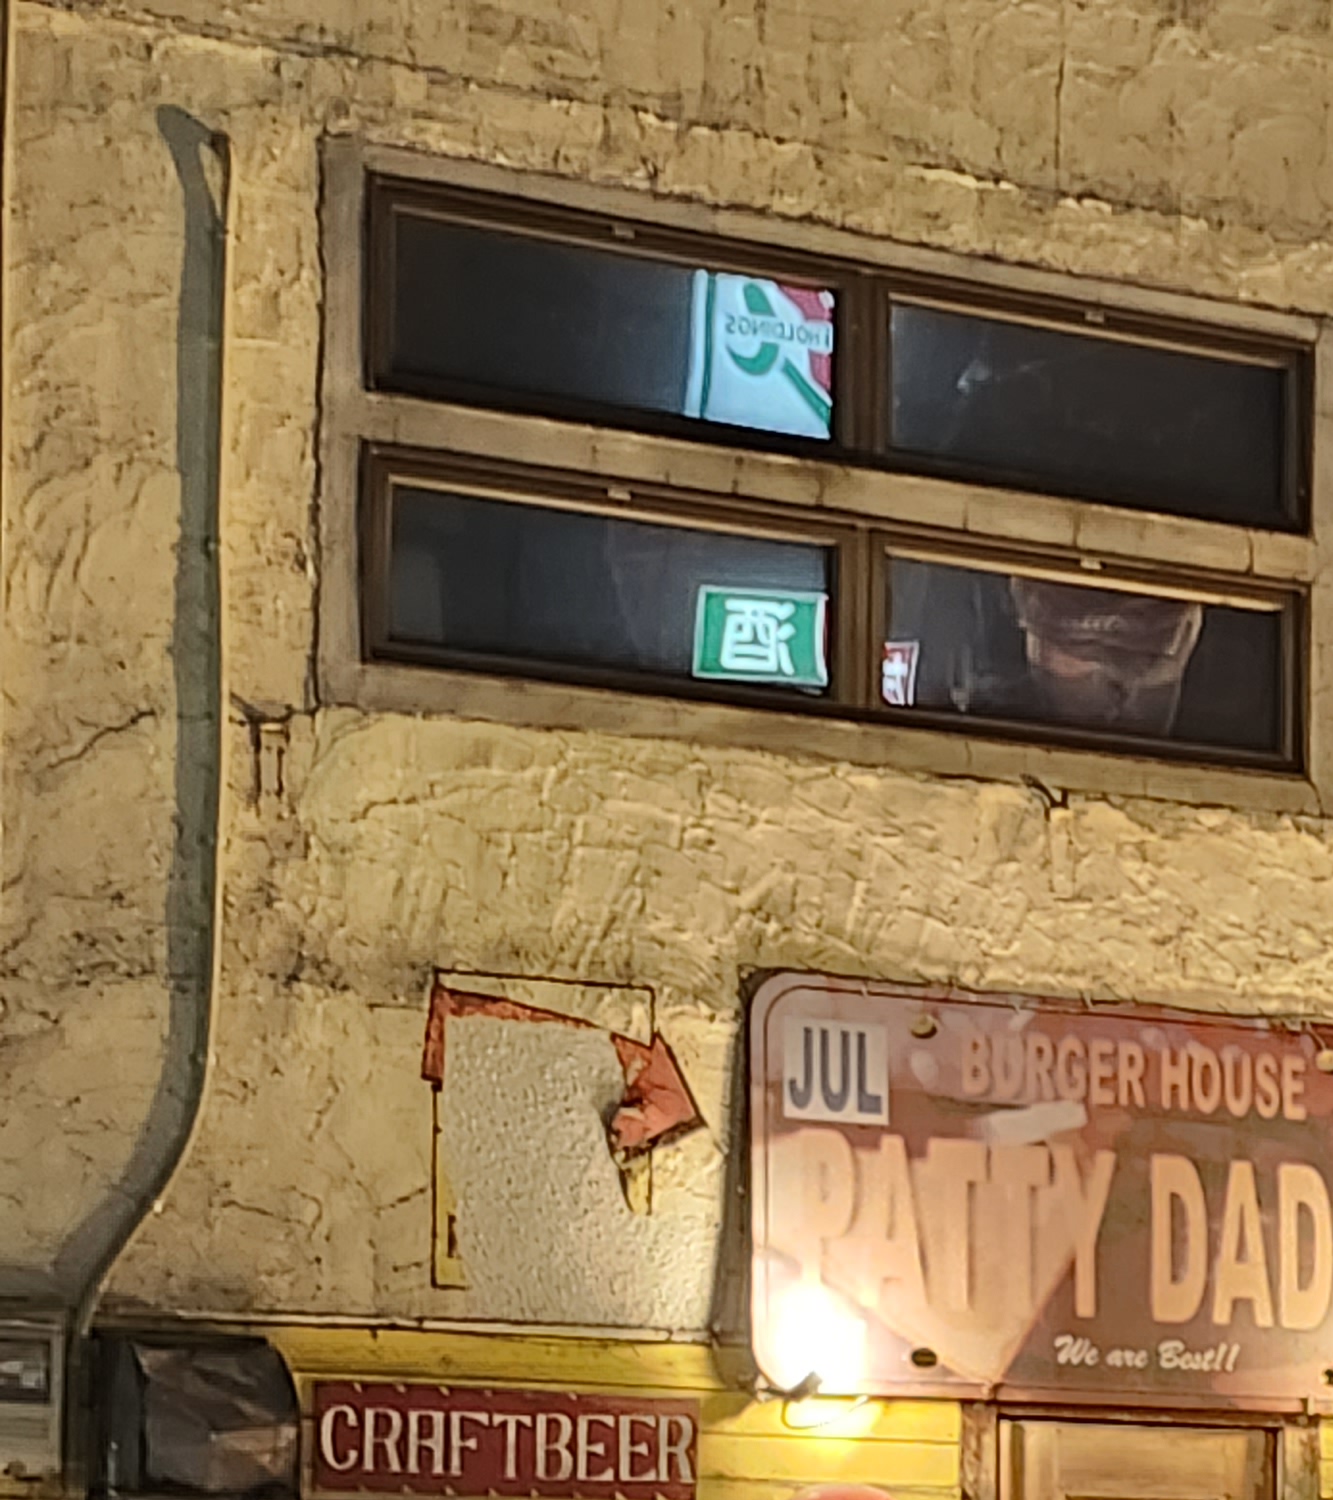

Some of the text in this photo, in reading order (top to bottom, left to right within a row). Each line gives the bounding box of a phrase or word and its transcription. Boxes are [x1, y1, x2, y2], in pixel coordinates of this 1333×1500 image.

[789, 1027, 883, 1114] JUL
[962, 1031, 1307, 1121] BURGER HOUSE
[799, 1128, 1117, 1318] PATTY
[1054, 1334, 1099, 1366] We
[1106, 1349, 1148, 1368] are
